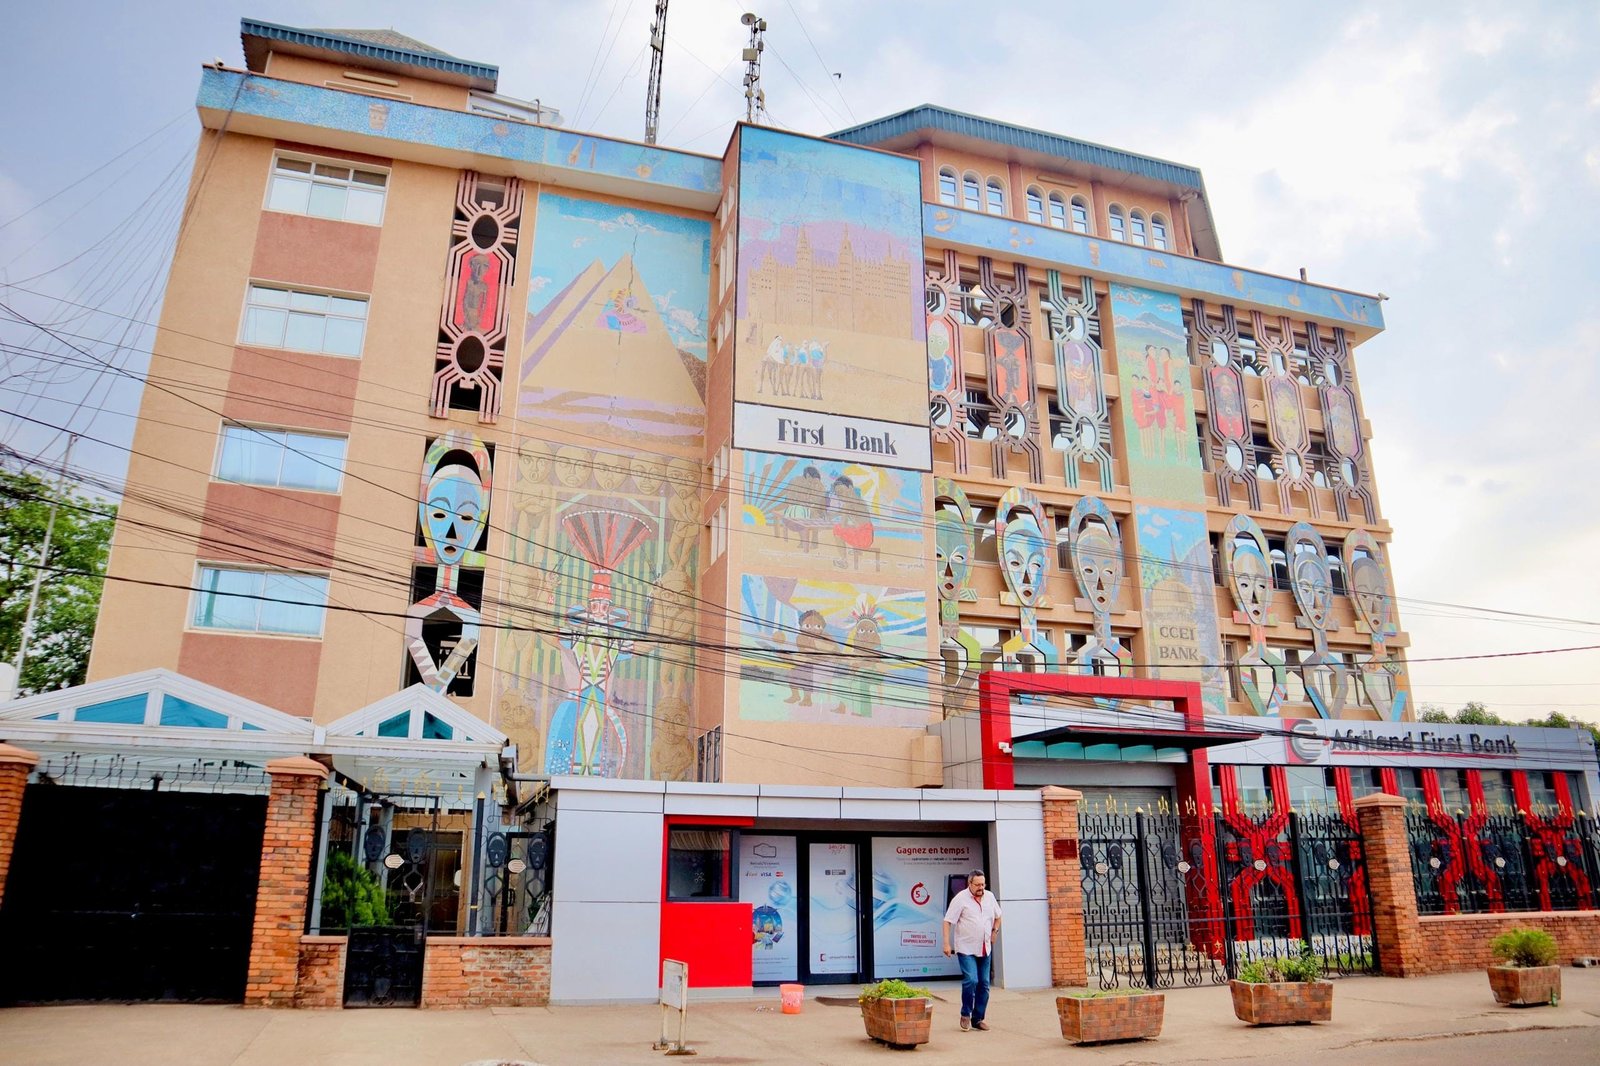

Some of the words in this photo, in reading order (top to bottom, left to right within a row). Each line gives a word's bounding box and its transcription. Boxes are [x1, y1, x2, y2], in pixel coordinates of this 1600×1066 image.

[777, 418, 824, 446] First
[845, 426, 898, 455] Bank
[1160, 626, 1196, 640] CCEI
[1159, 646, 1199, 660] BANK
[1332, 728, 1413, 752] Afriland
[1420, 731, 1464, 752] First
[1469, 733, 1519, 755] Bank
[896, 846, 926, 856] Gagnez
[940, 846, 965, 856] temps
